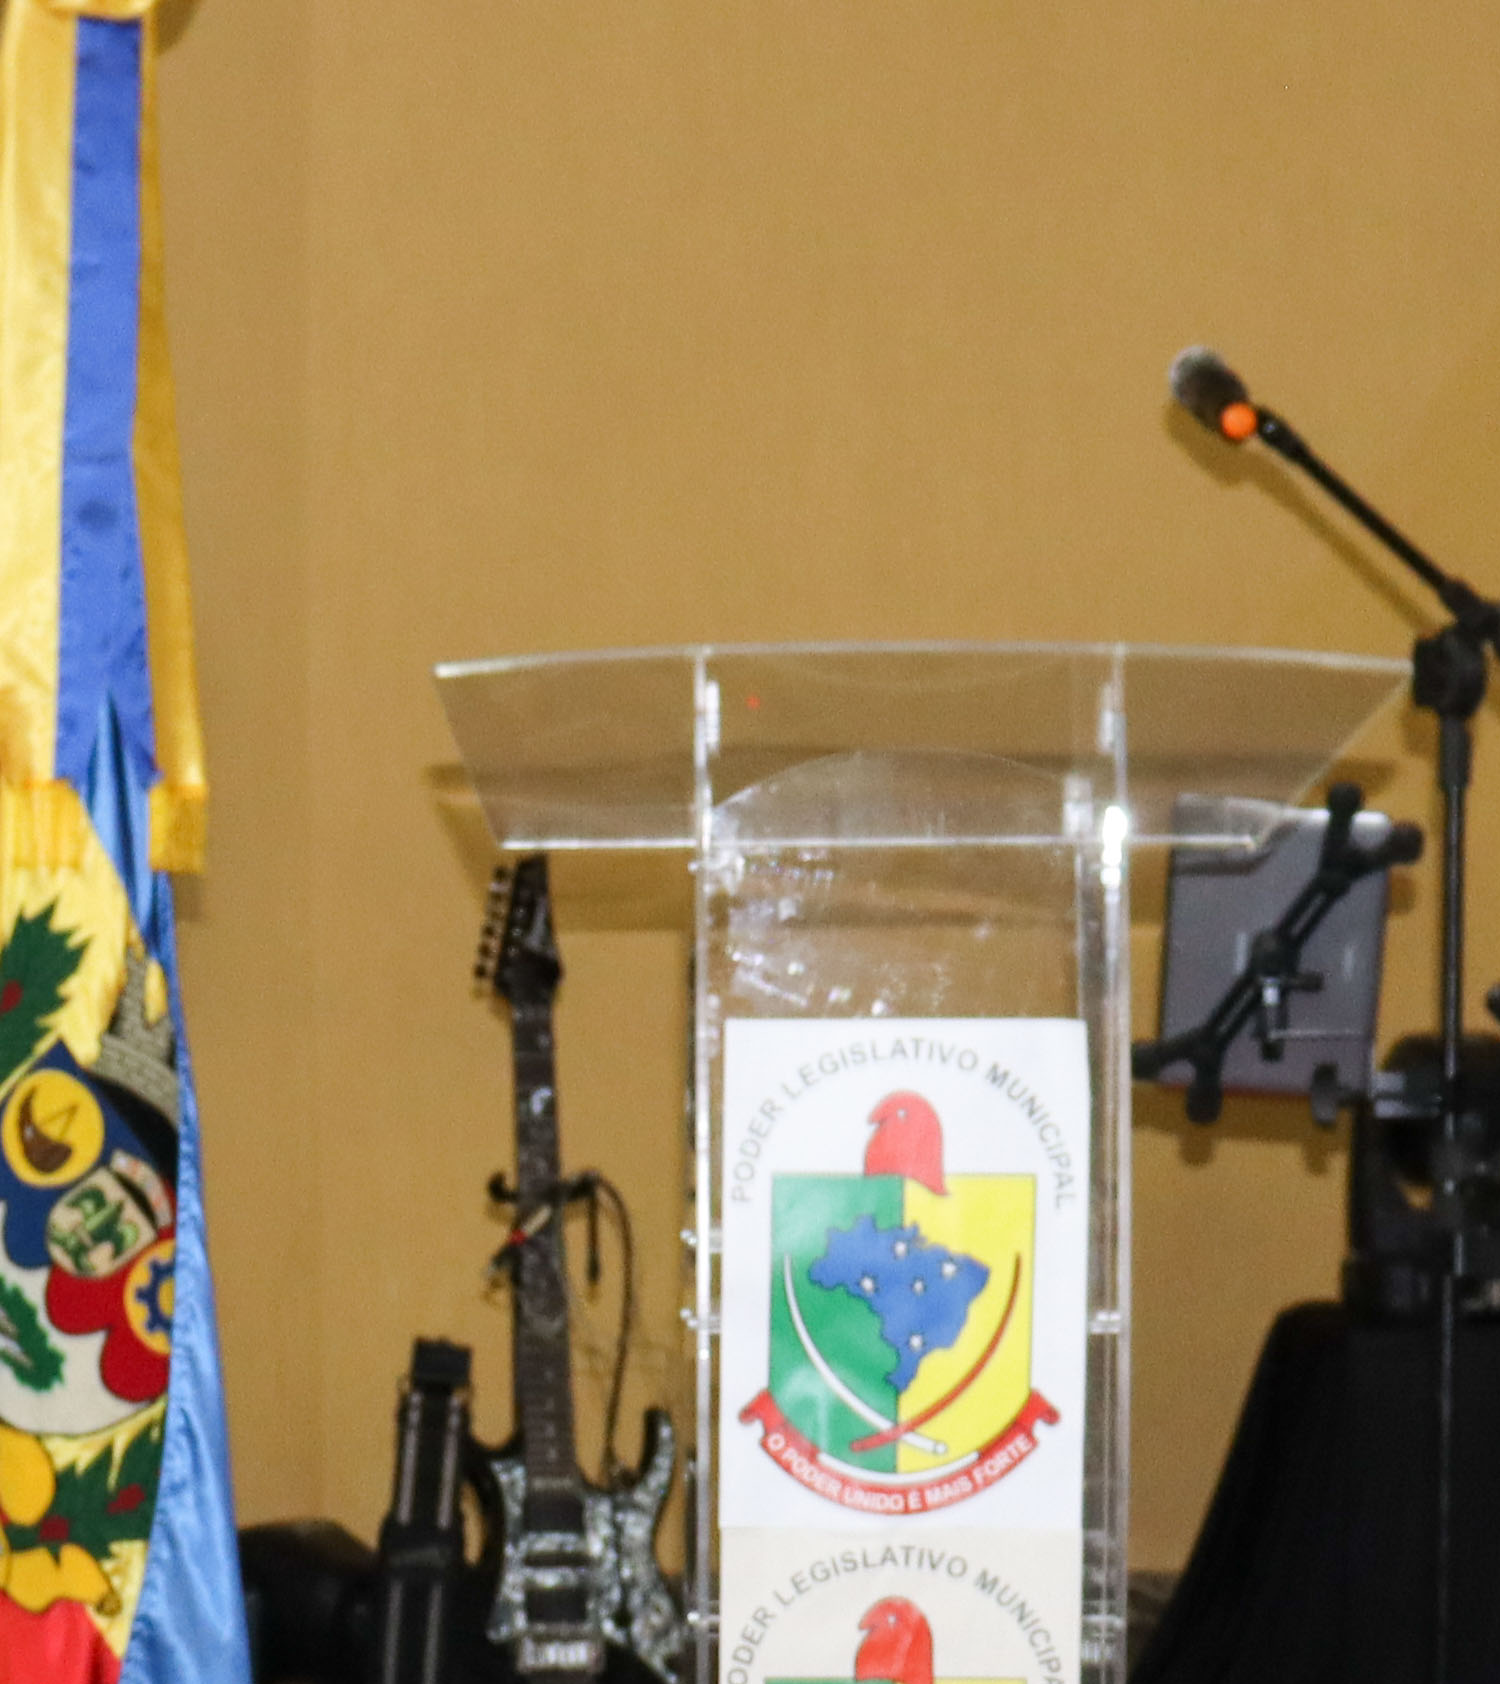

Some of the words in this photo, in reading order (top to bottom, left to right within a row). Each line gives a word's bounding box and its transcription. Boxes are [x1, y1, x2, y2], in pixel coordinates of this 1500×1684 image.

[731, 1099, 784, 1202] PODER
[781, 1037, 978, 1101] LEGISLATIVO
[985, 1063, 1076, 1208] MUNICIPAL
[767, 1433, 784, 1451] O
[782, 1450, 844, 1496] PODER
[844, 1487, 904, 1510] UNIDO
[926, 1476, 973, 1505] MAIS
[973, 1435, 1032, 1487] FORTE
[773, 1546, 967, 1607] LEGISLATIVO
